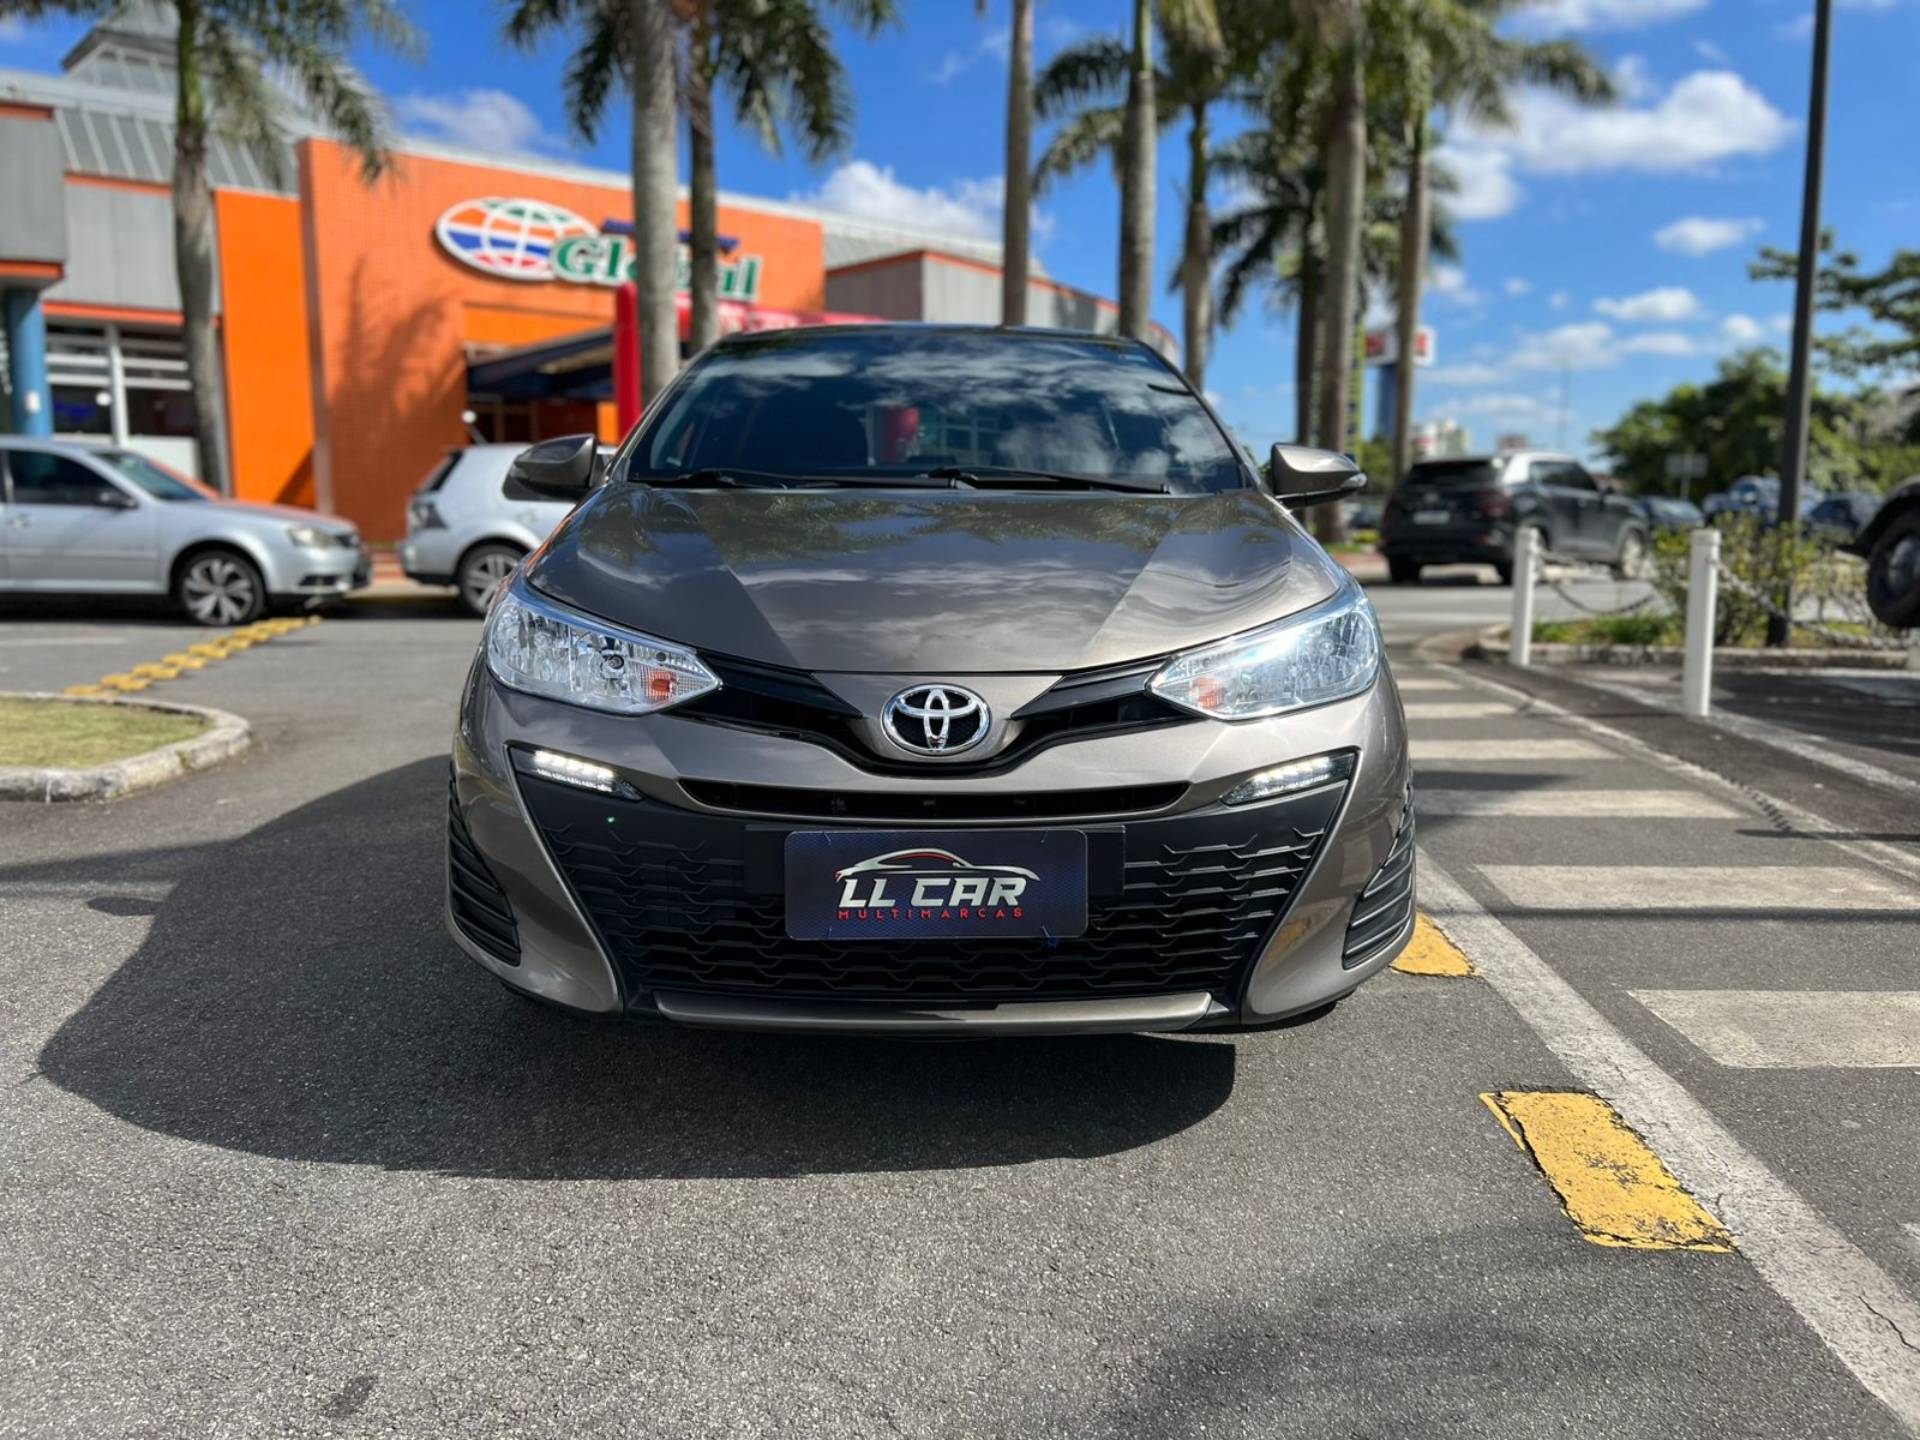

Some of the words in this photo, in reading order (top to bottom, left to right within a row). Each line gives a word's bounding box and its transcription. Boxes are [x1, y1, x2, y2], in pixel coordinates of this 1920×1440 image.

[554, 236, 761, 299] Gll
[838, 878, 896, 908] LL
[910, 877, 1027, 907] CAR
[838, 908, 1024, 920] MULTIMARCAS
